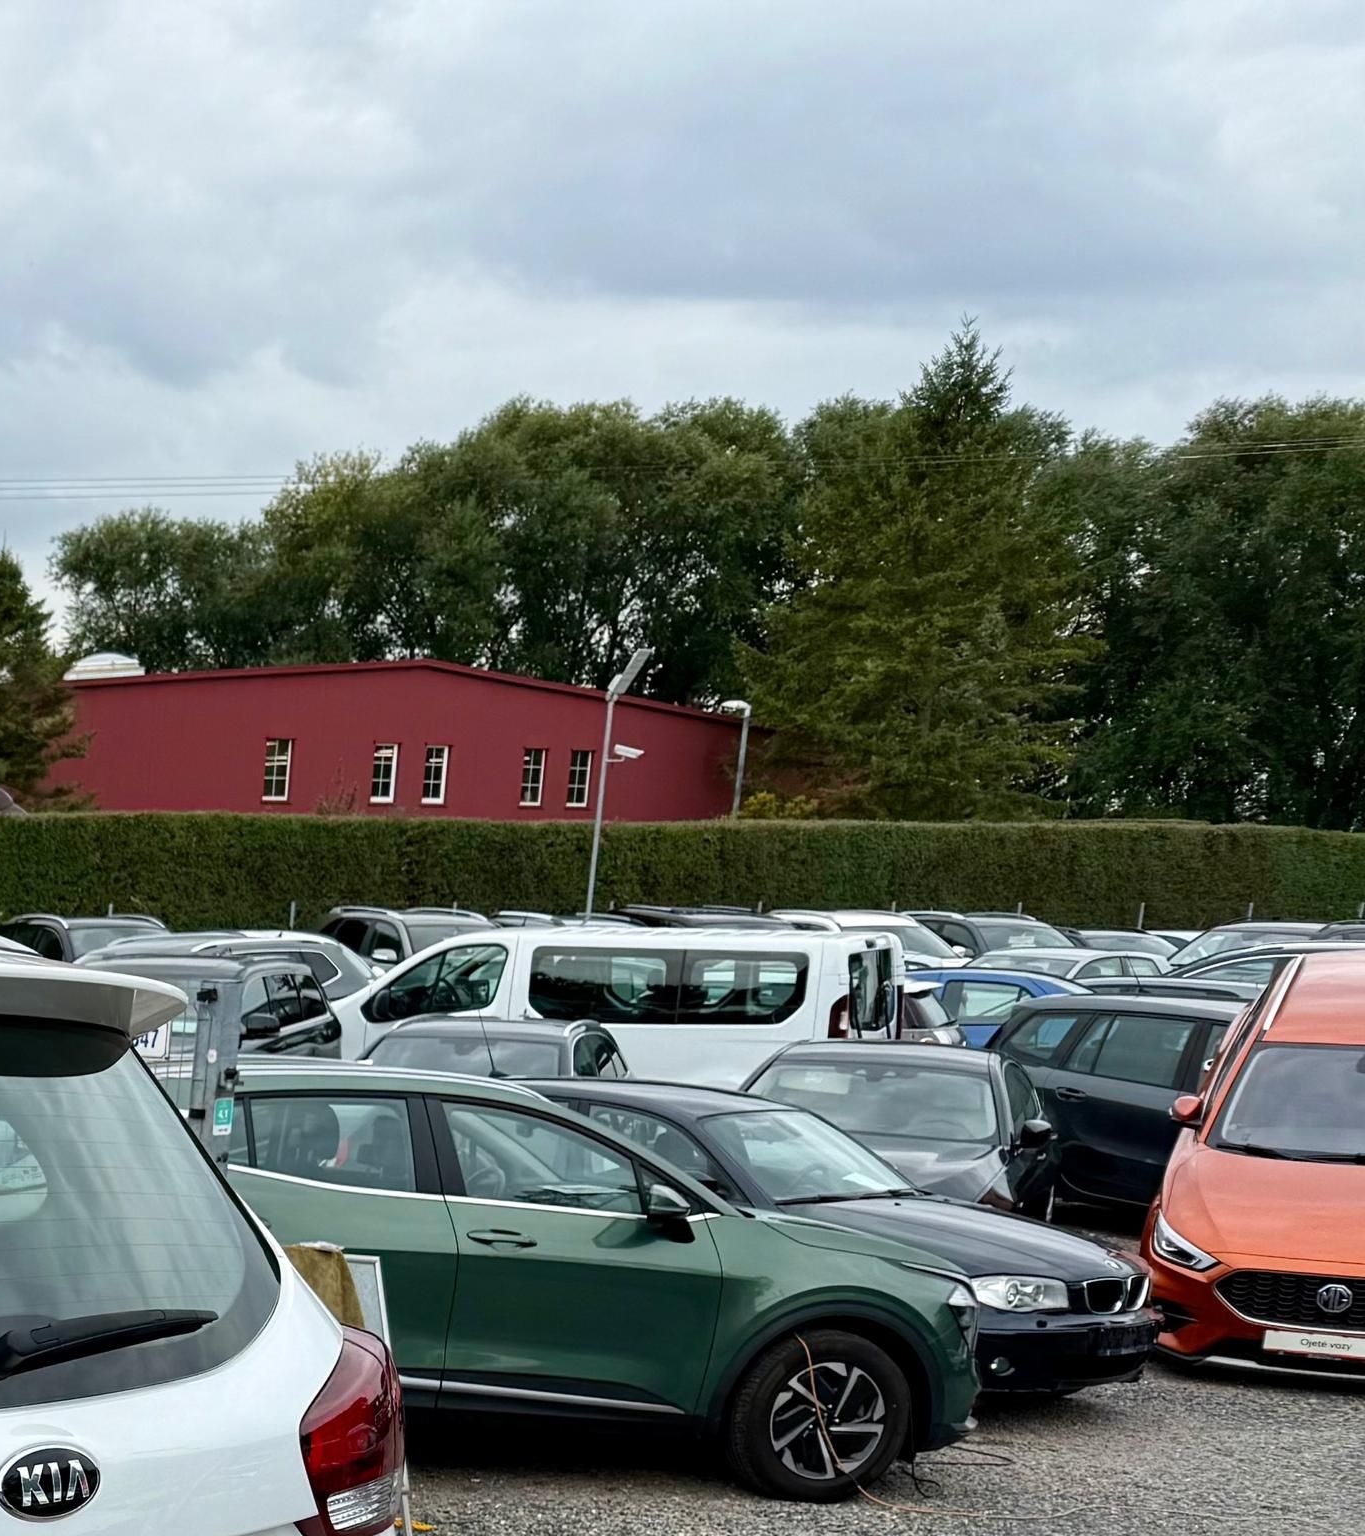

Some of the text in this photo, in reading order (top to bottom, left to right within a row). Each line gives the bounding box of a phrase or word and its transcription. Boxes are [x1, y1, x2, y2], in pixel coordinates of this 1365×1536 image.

[1320, 1287, 1350, 1311] MG
[1330, 1342, 1353, 1351] vozy
[16, 1459, 90, 1507] KIA
